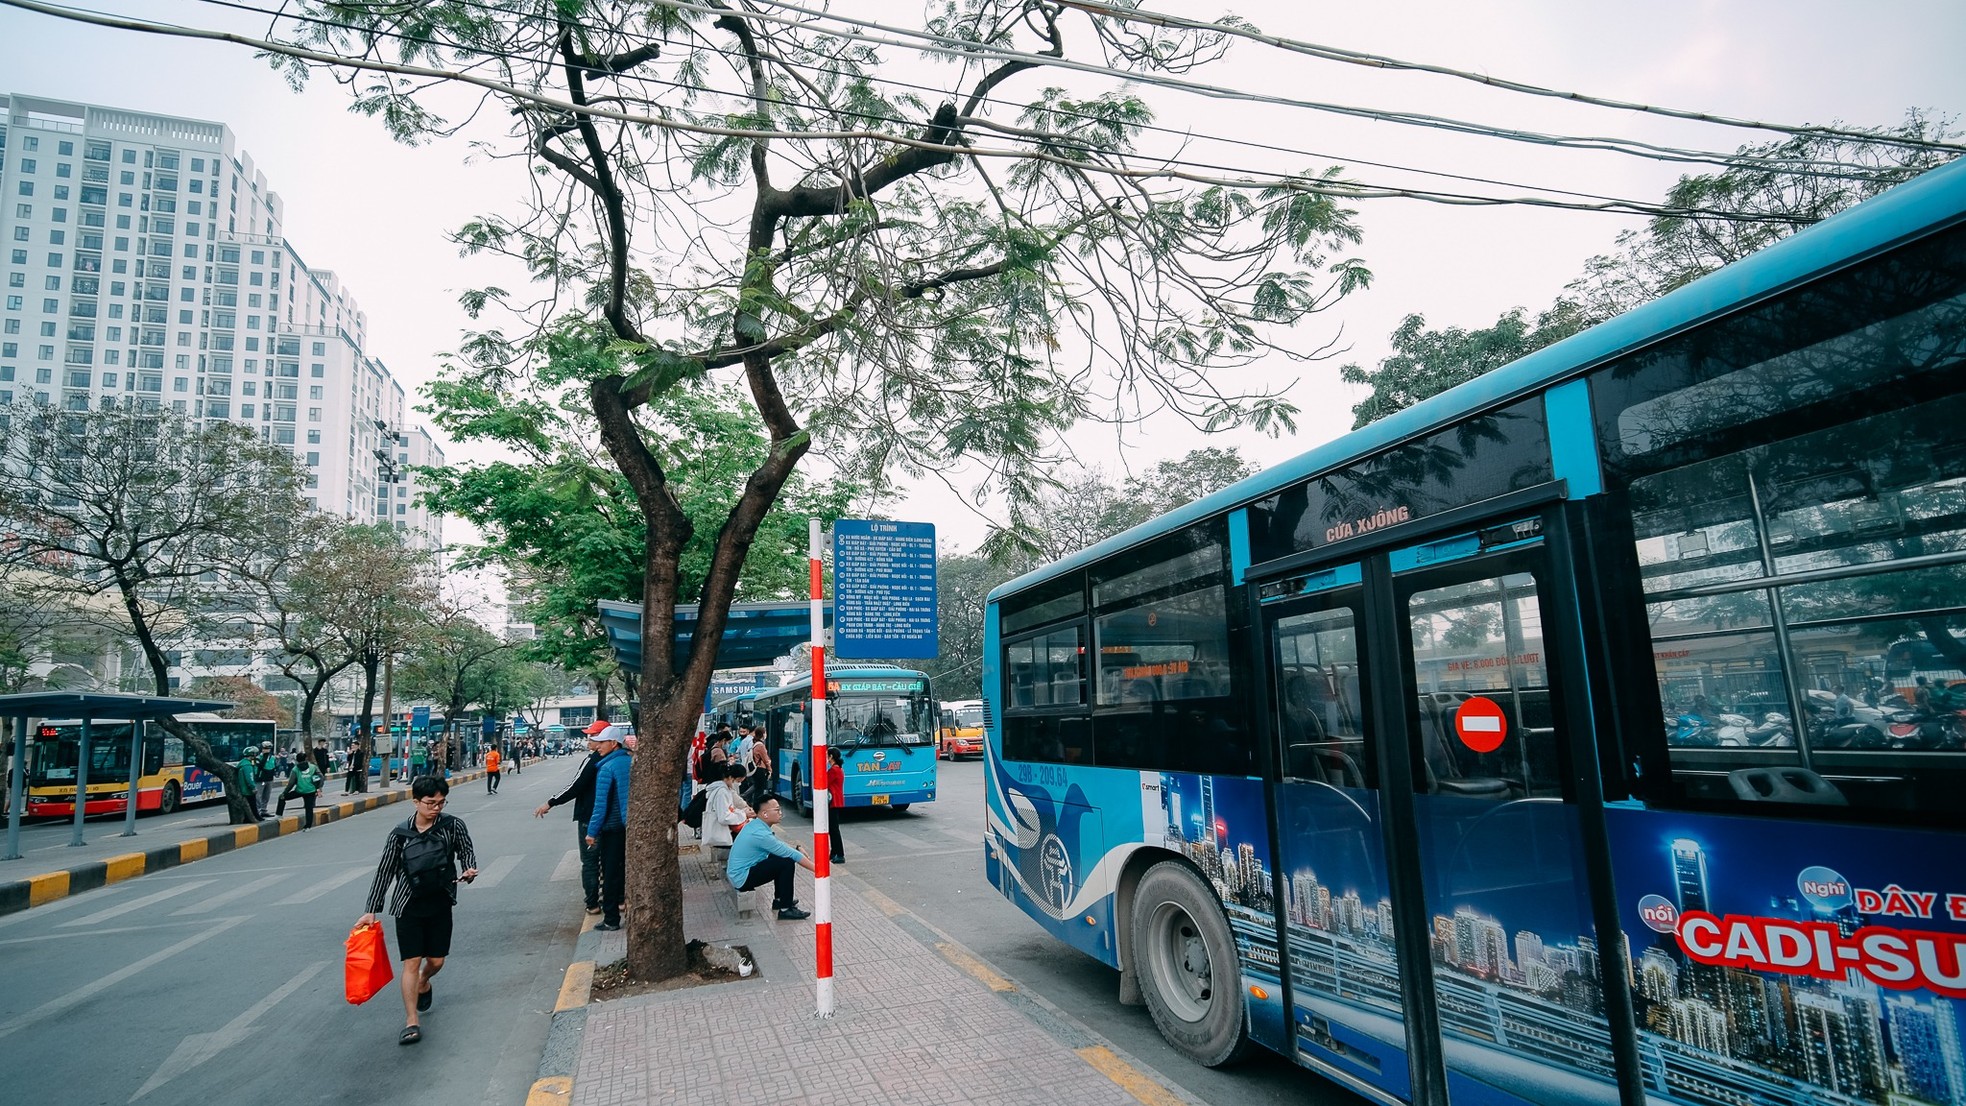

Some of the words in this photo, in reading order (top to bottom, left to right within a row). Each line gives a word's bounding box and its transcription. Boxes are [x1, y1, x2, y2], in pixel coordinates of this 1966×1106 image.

[870, 524, 878, 532] LỘ
[1326, 520, 1354, 542] CỬA
[1018, 764, 1032, 782] 29B
[1040, 765, 1068, 787] 209.64
[1804, 881, 1846, 898] Nghĩ
[1854, 884, 1938, 919] DÂY
